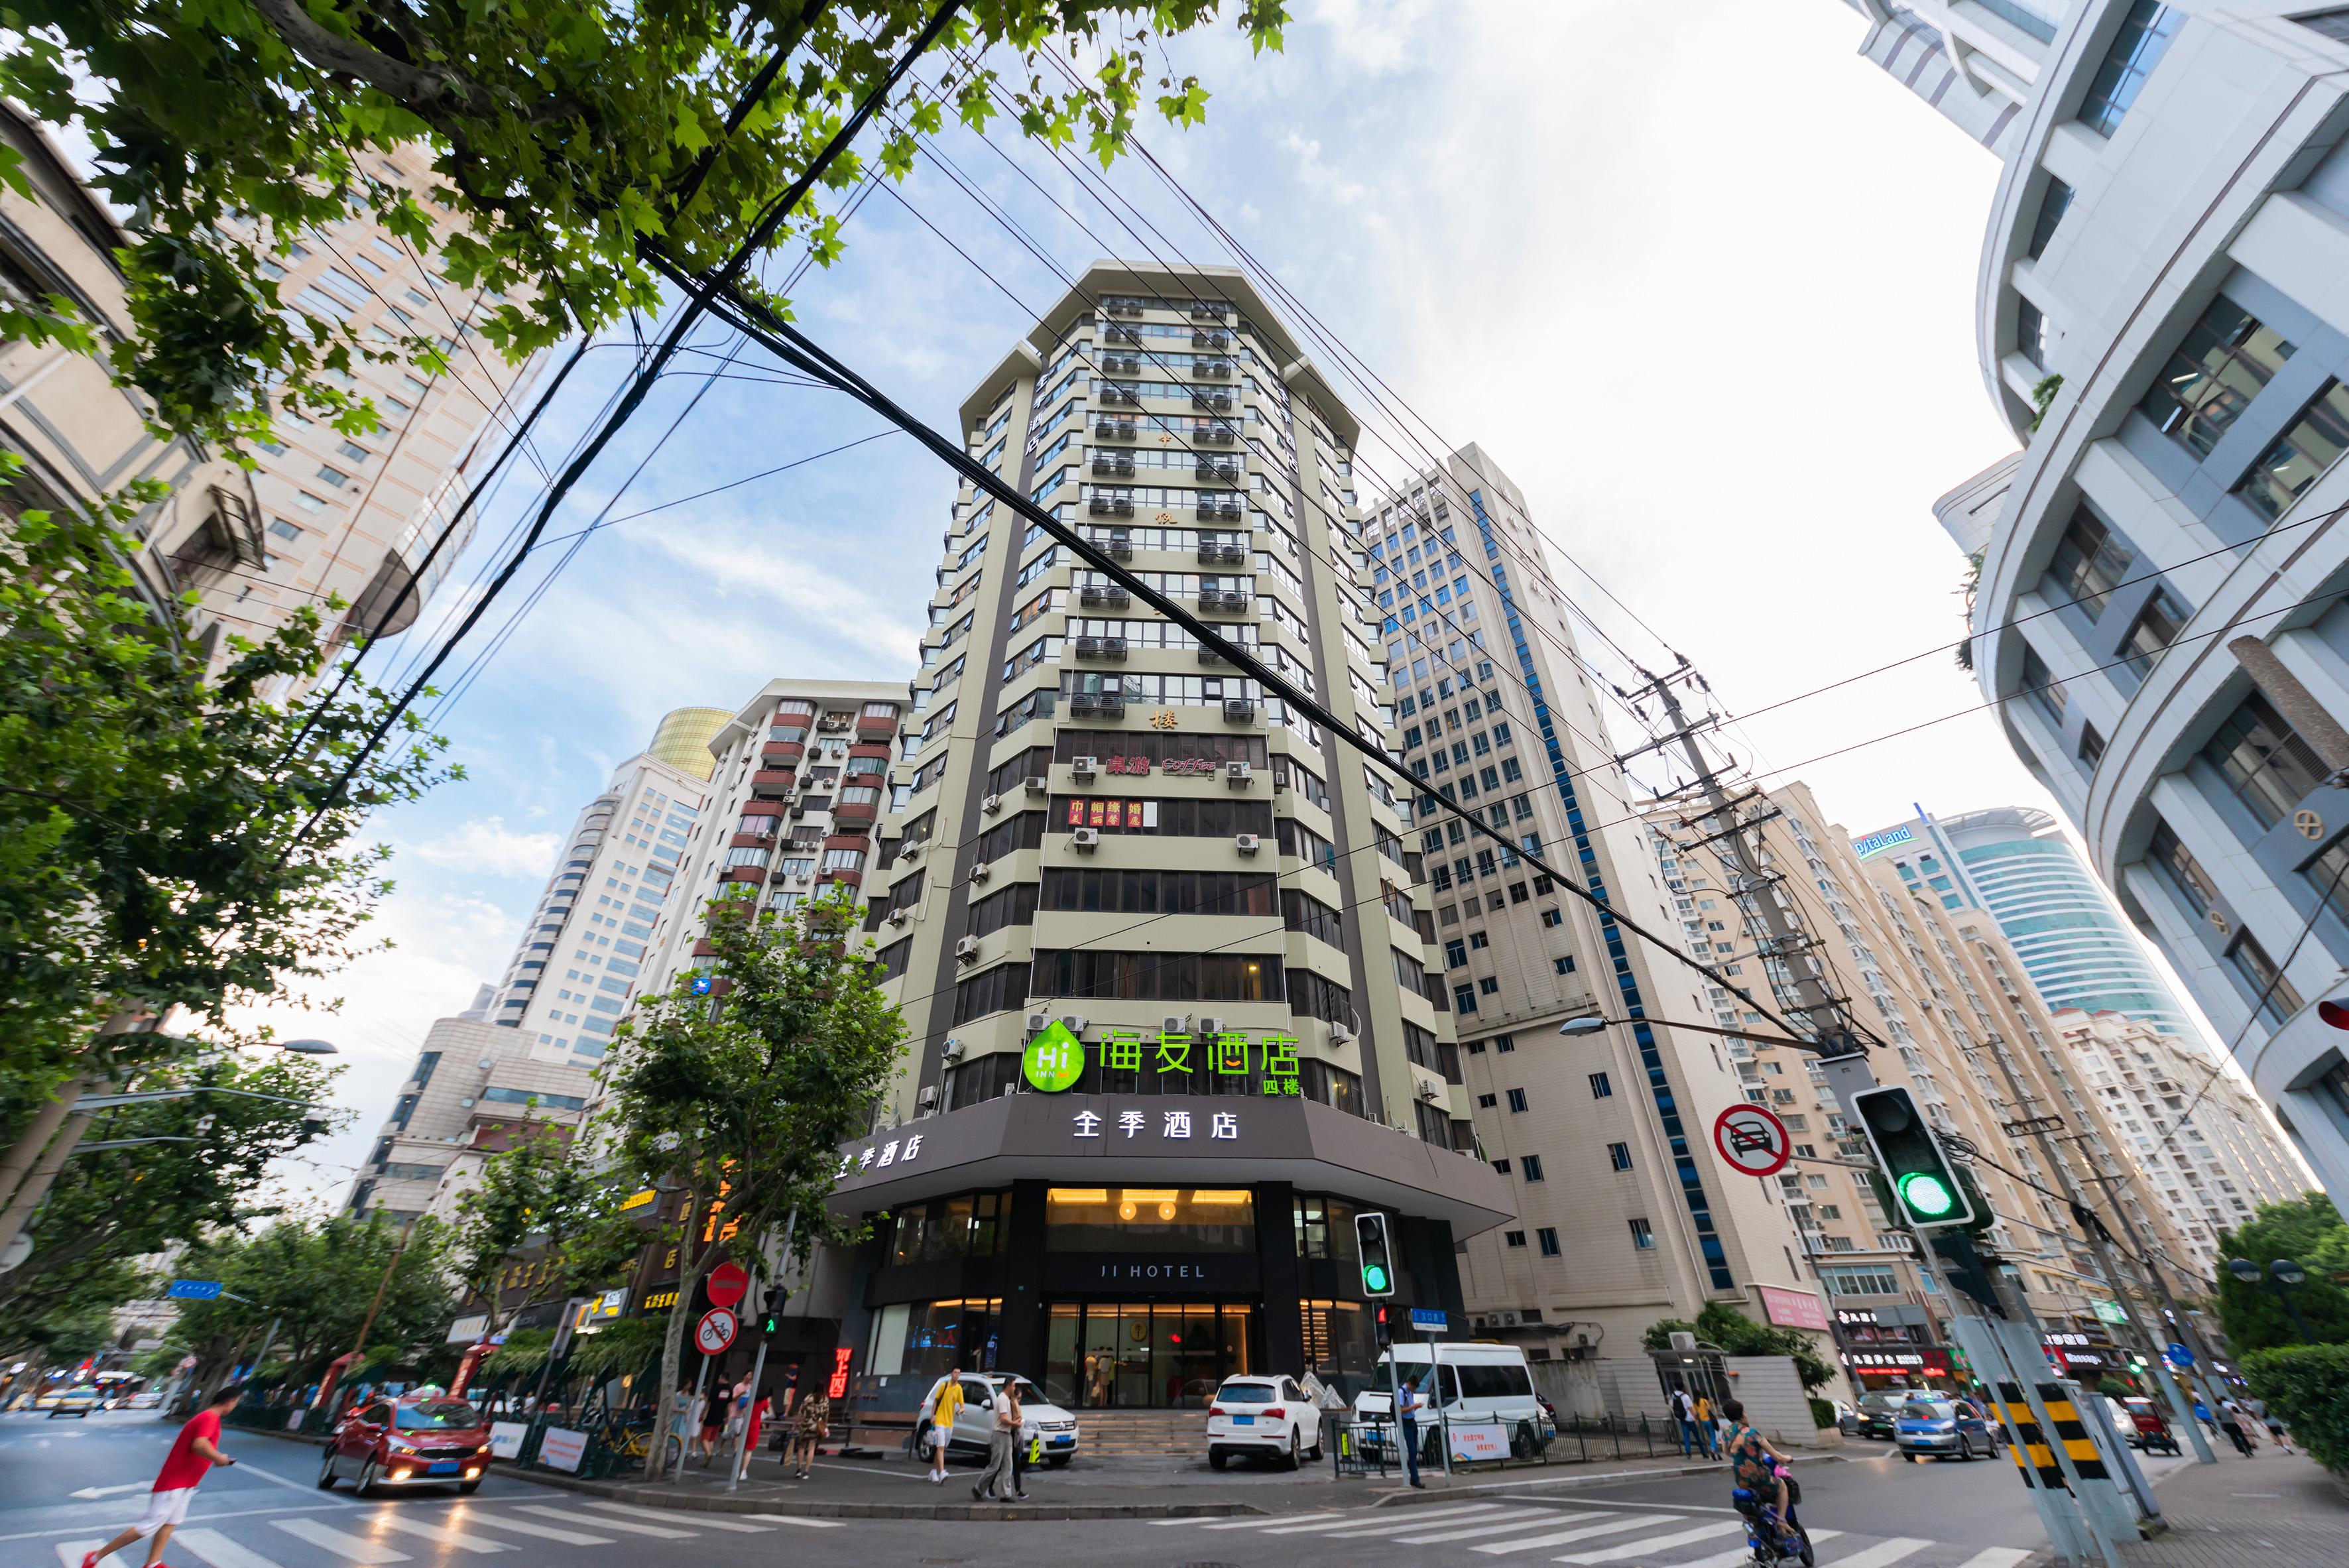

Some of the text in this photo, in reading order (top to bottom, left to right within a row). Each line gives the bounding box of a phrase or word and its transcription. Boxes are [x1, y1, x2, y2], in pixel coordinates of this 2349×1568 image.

[1106, 755, 1150, 775] 桌游
[1162, 758, 1216, 774] Coffee
[1038, 1042, 1069, 1069] Hi
[1100, 1028, 1299, 1075] 海友酒店
[1263, 1078, 1300, 1095] 四楼
[1073, 1111, 1238, 1139] 全季酒店
[1101, 1265, 1205, 1278] JI HOTEL
